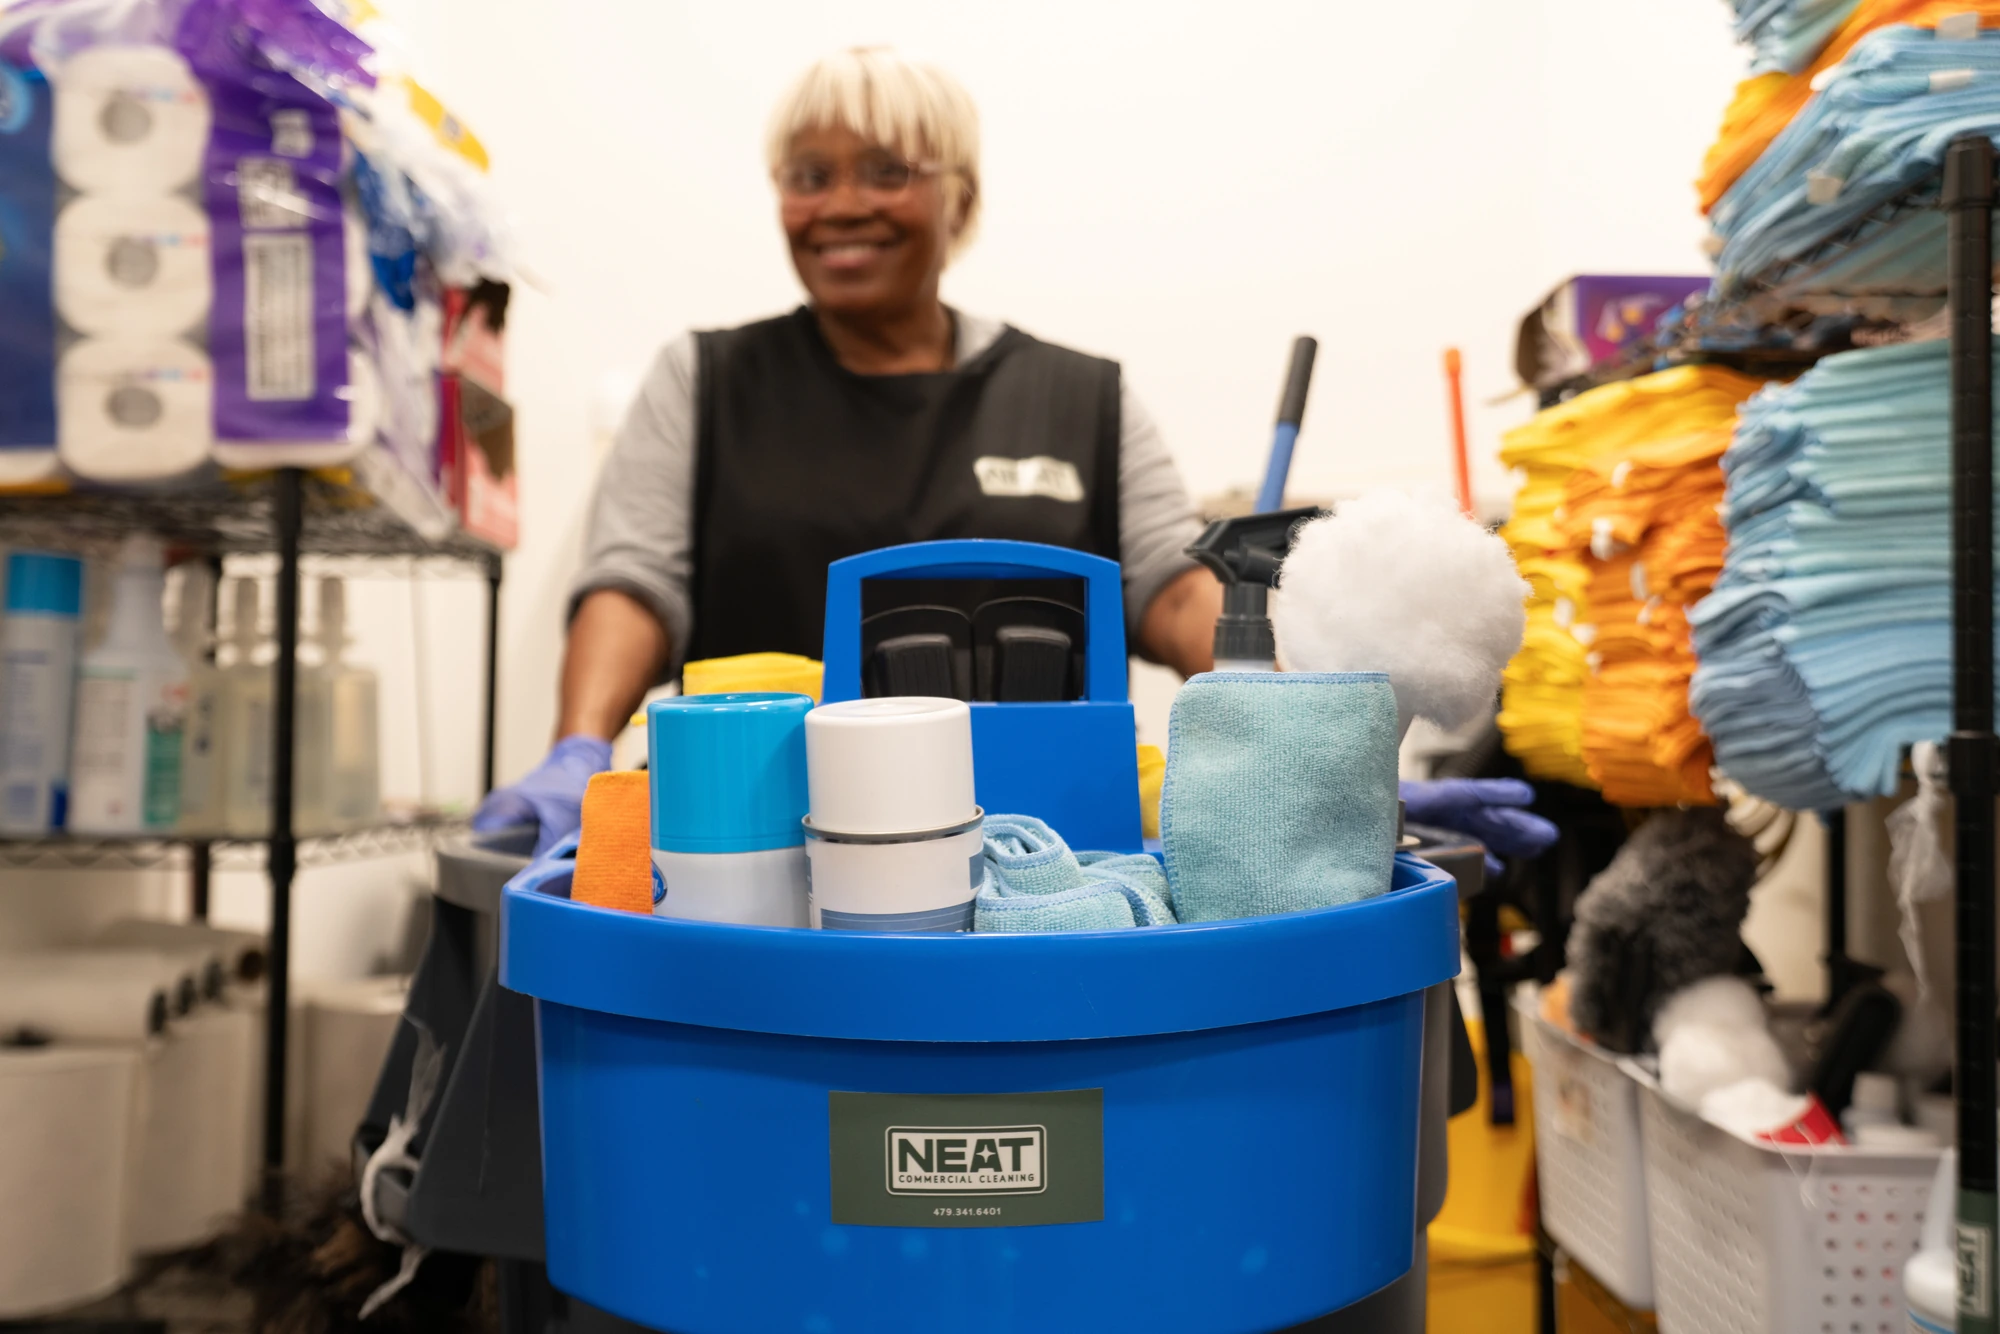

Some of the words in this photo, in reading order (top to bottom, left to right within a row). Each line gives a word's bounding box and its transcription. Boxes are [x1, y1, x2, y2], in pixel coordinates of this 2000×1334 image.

[898, 1137, 1034, 1173] NEAT
[898, 1175, 972, 1184] COMMERCIAL
[979, 1173, 1035, 1183] CLEANING
[933, 1207, 1001, 1217] 479.341.6401
